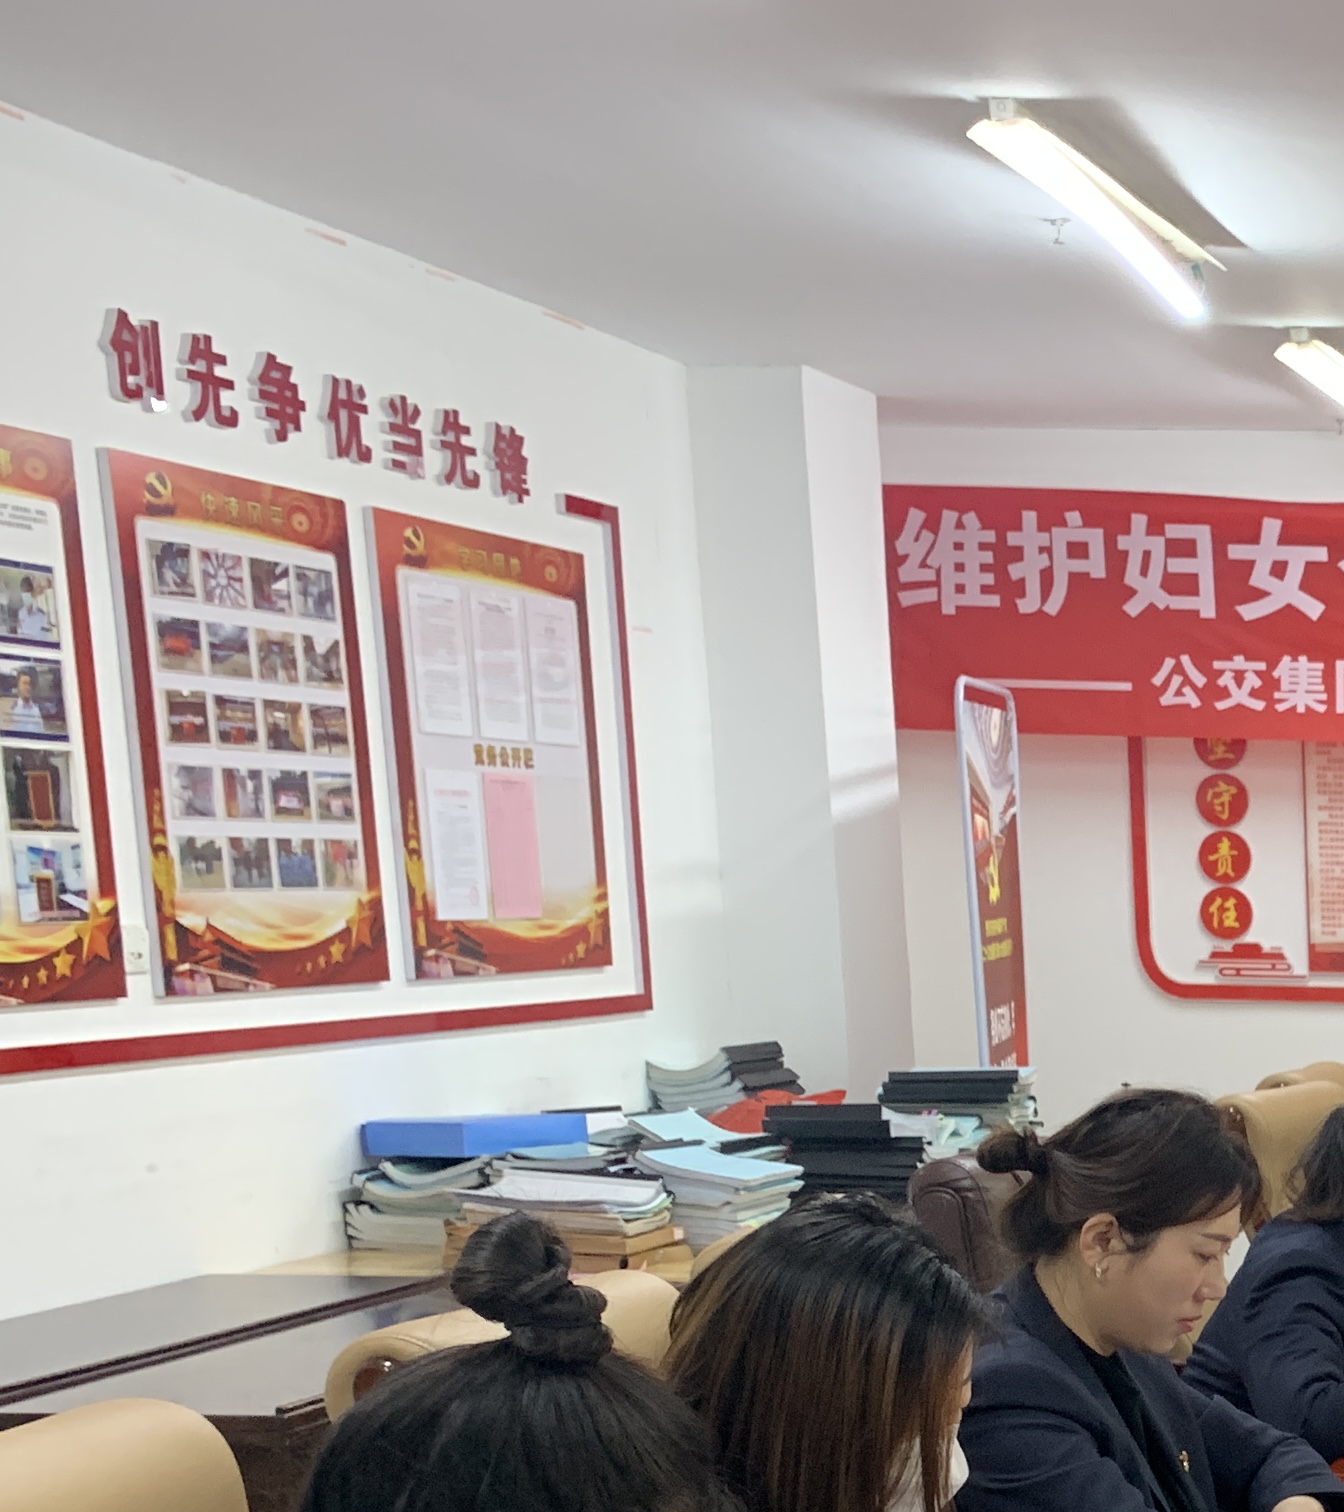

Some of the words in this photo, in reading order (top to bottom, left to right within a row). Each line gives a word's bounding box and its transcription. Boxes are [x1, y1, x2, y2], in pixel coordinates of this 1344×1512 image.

[104, 307, 533, 504] 创先争优当先锋
